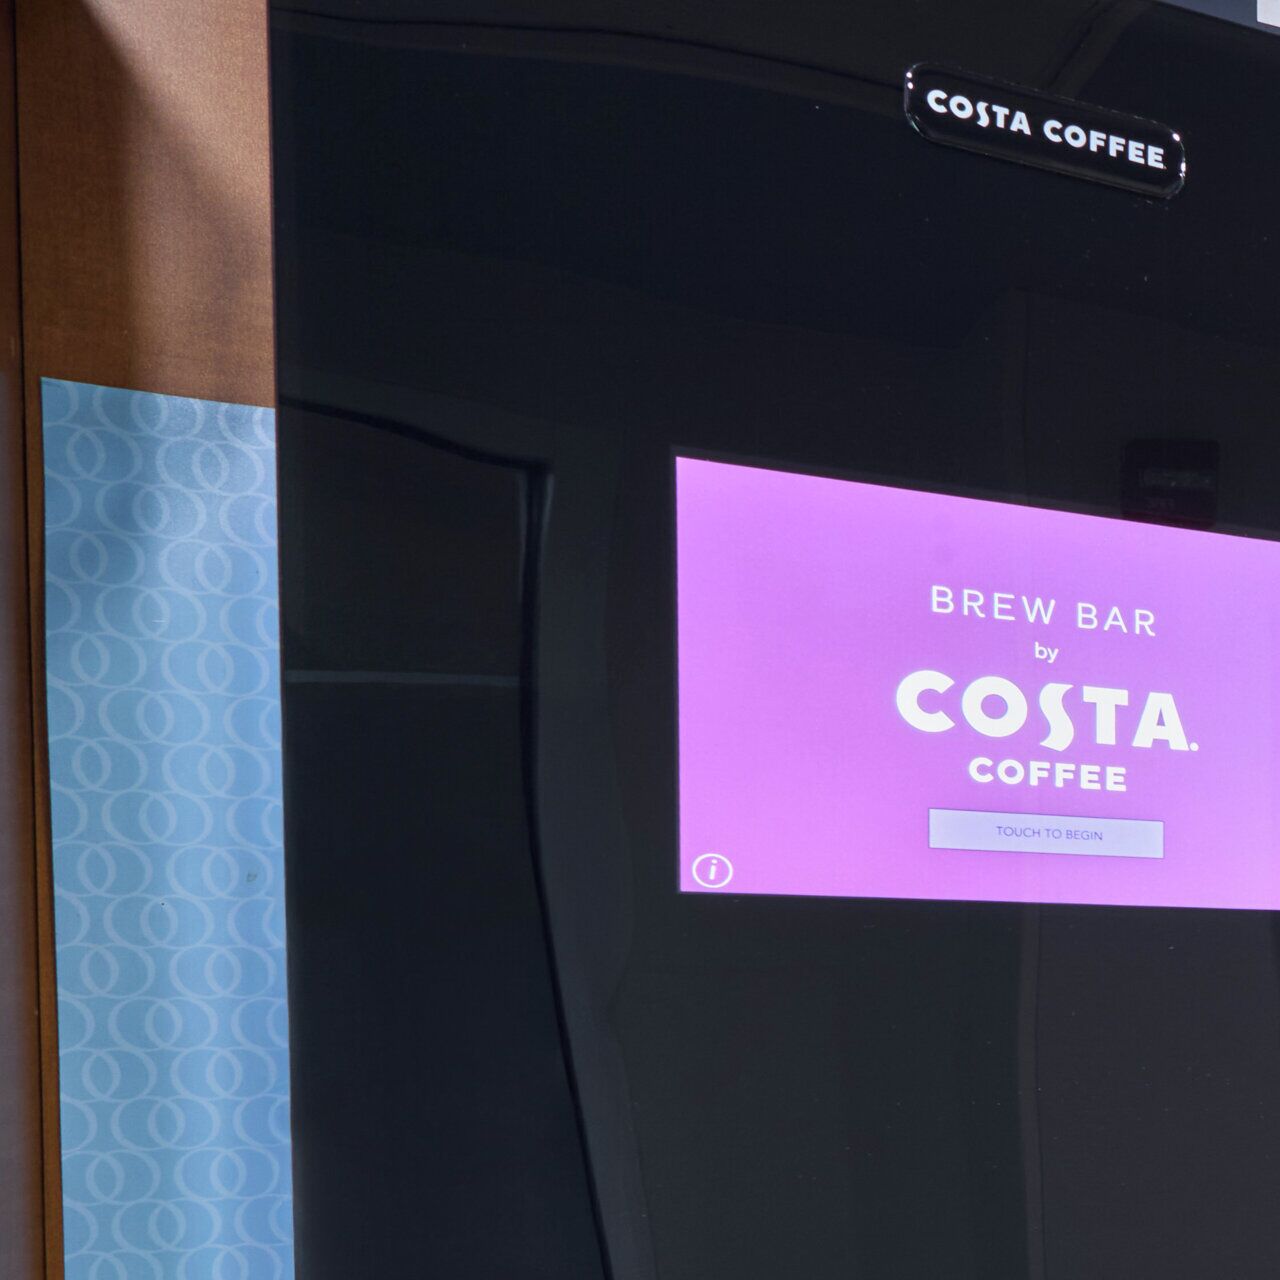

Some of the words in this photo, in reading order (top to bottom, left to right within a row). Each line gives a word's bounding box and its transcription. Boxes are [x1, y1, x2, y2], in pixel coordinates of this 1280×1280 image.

[926, 89, 1031, 136] COSTA
[1043, 119, 1165, 169] COFFEE
[931, 585, 1055, 624] BREW
[1077, 602, 1155, 636] BAR
[1034, 641, 1058, 663] by
[968, 757, 1126, 792] COFFEE
[996, 825, 1041, 839] TOUCH
[1045, 827, 1062, 839] TO
[1066, 829, 1103, 841] BEGIN
